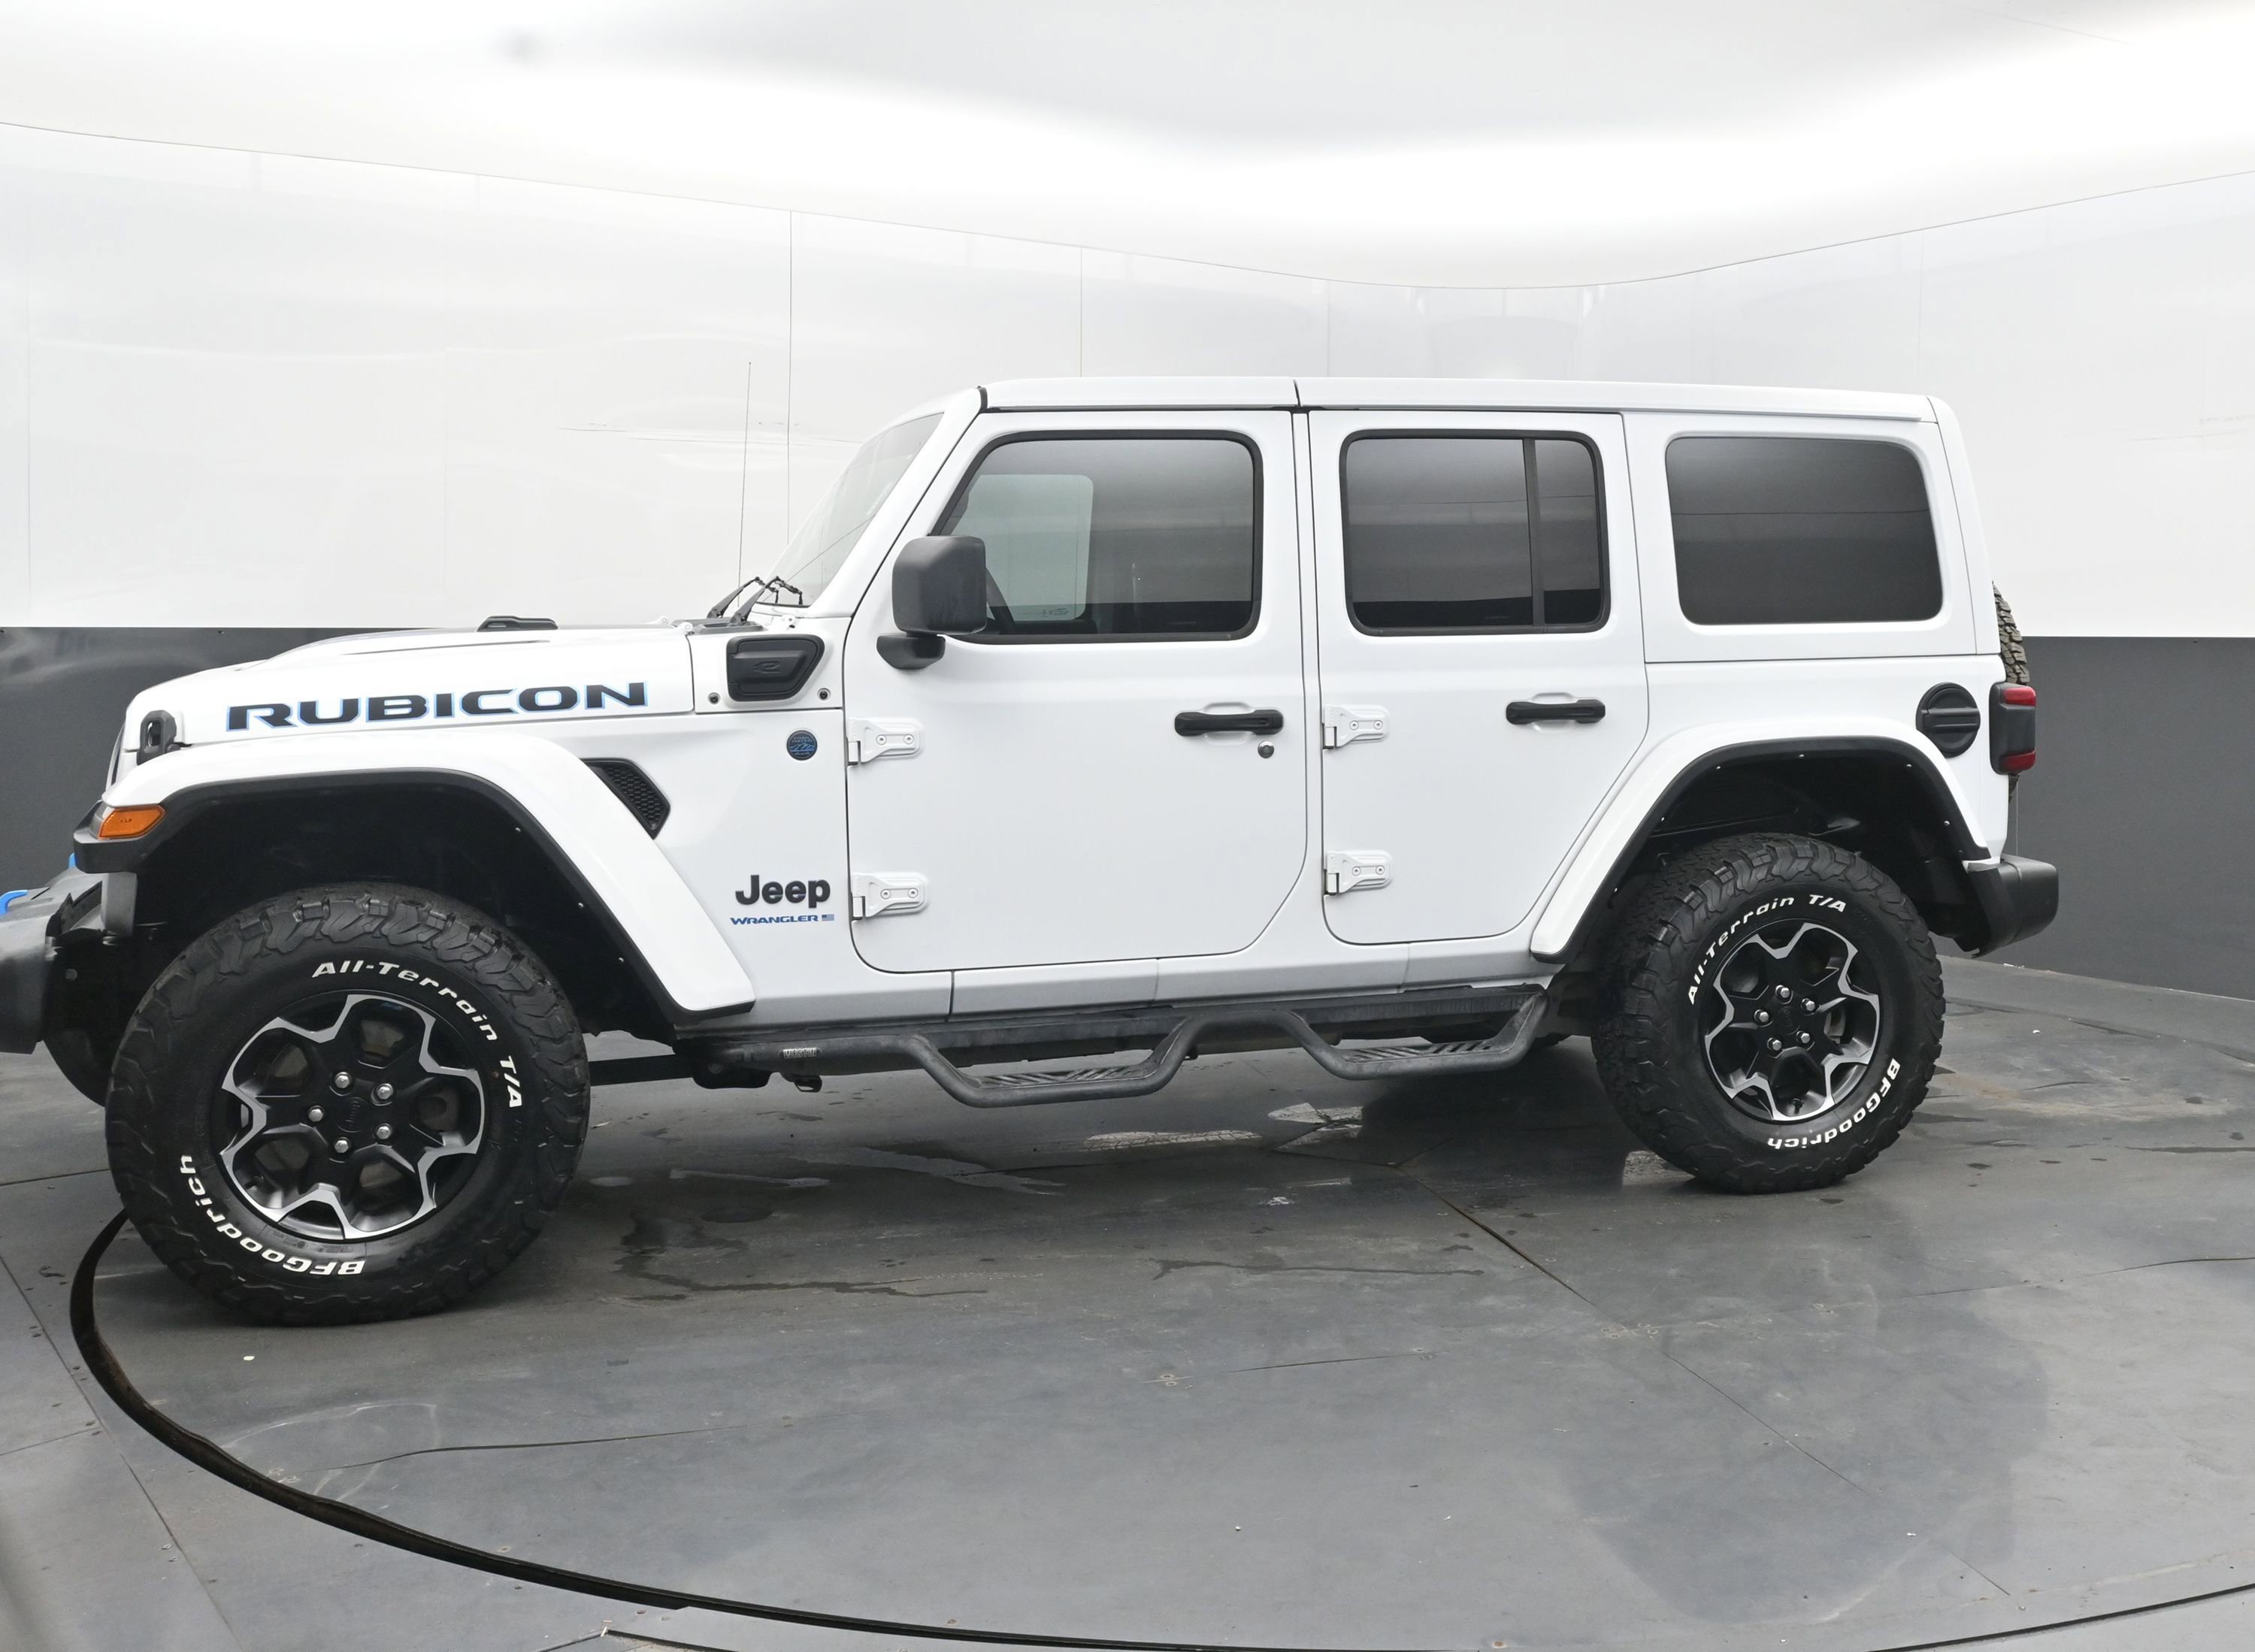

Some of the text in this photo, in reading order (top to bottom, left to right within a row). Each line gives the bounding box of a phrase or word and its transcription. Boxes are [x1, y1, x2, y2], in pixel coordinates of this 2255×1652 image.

[225, 681, 648, 732] RUBICON
[730, 914, 819, 925] WRANGLER
[735, 874, 831, 909] Jeep
[1688, 894, 1846, 1005] All-Terrain T/A
[312, 960, 522, 1109] All-Terrain T/A
[1766, 1057, 1901, 1150] BFGoodrich
[179, 1154, 366, 1276] BFGoodrich
